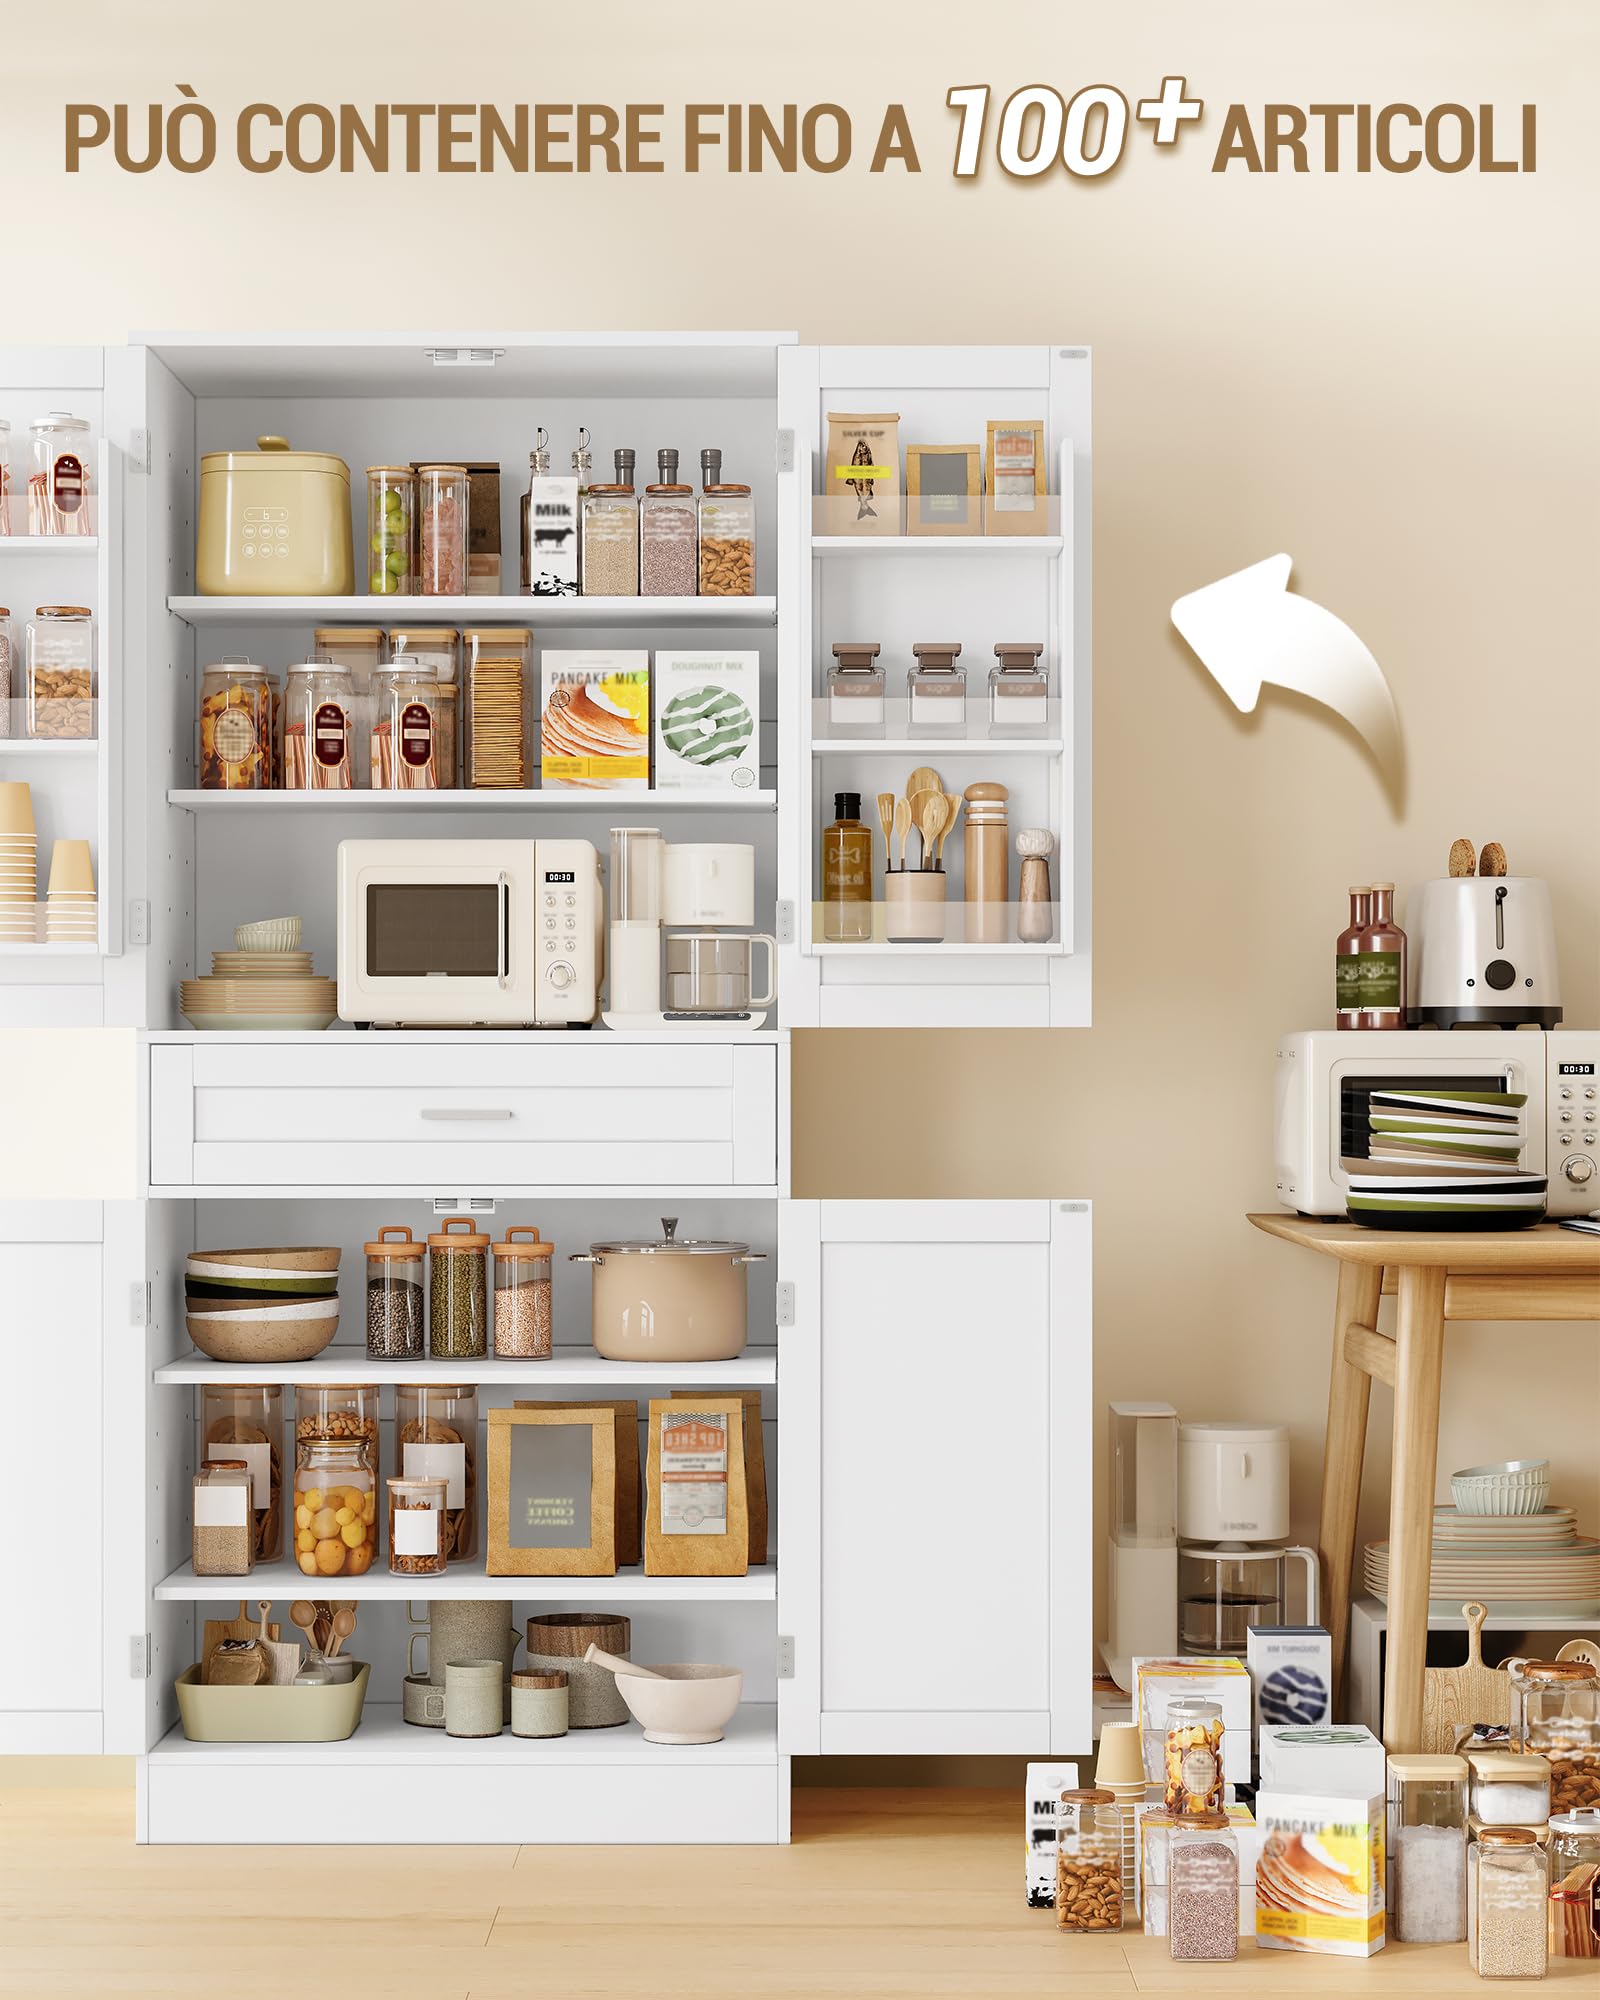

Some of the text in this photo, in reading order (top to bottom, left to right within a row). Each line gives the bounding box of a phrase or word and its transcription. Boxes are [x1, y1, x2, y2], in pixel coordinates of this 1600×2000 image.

[535, 504, 572, 517] Milk
[725, 661, 744, 671] MIX
[551, 672, 638, 685] PANCAKE MIX
[549, 873, 571, 881] 00:30
[1563, 1065, 1590, 1073] 00:30
[1265, 1817, 1358, 1838] PANCAKE MIX
